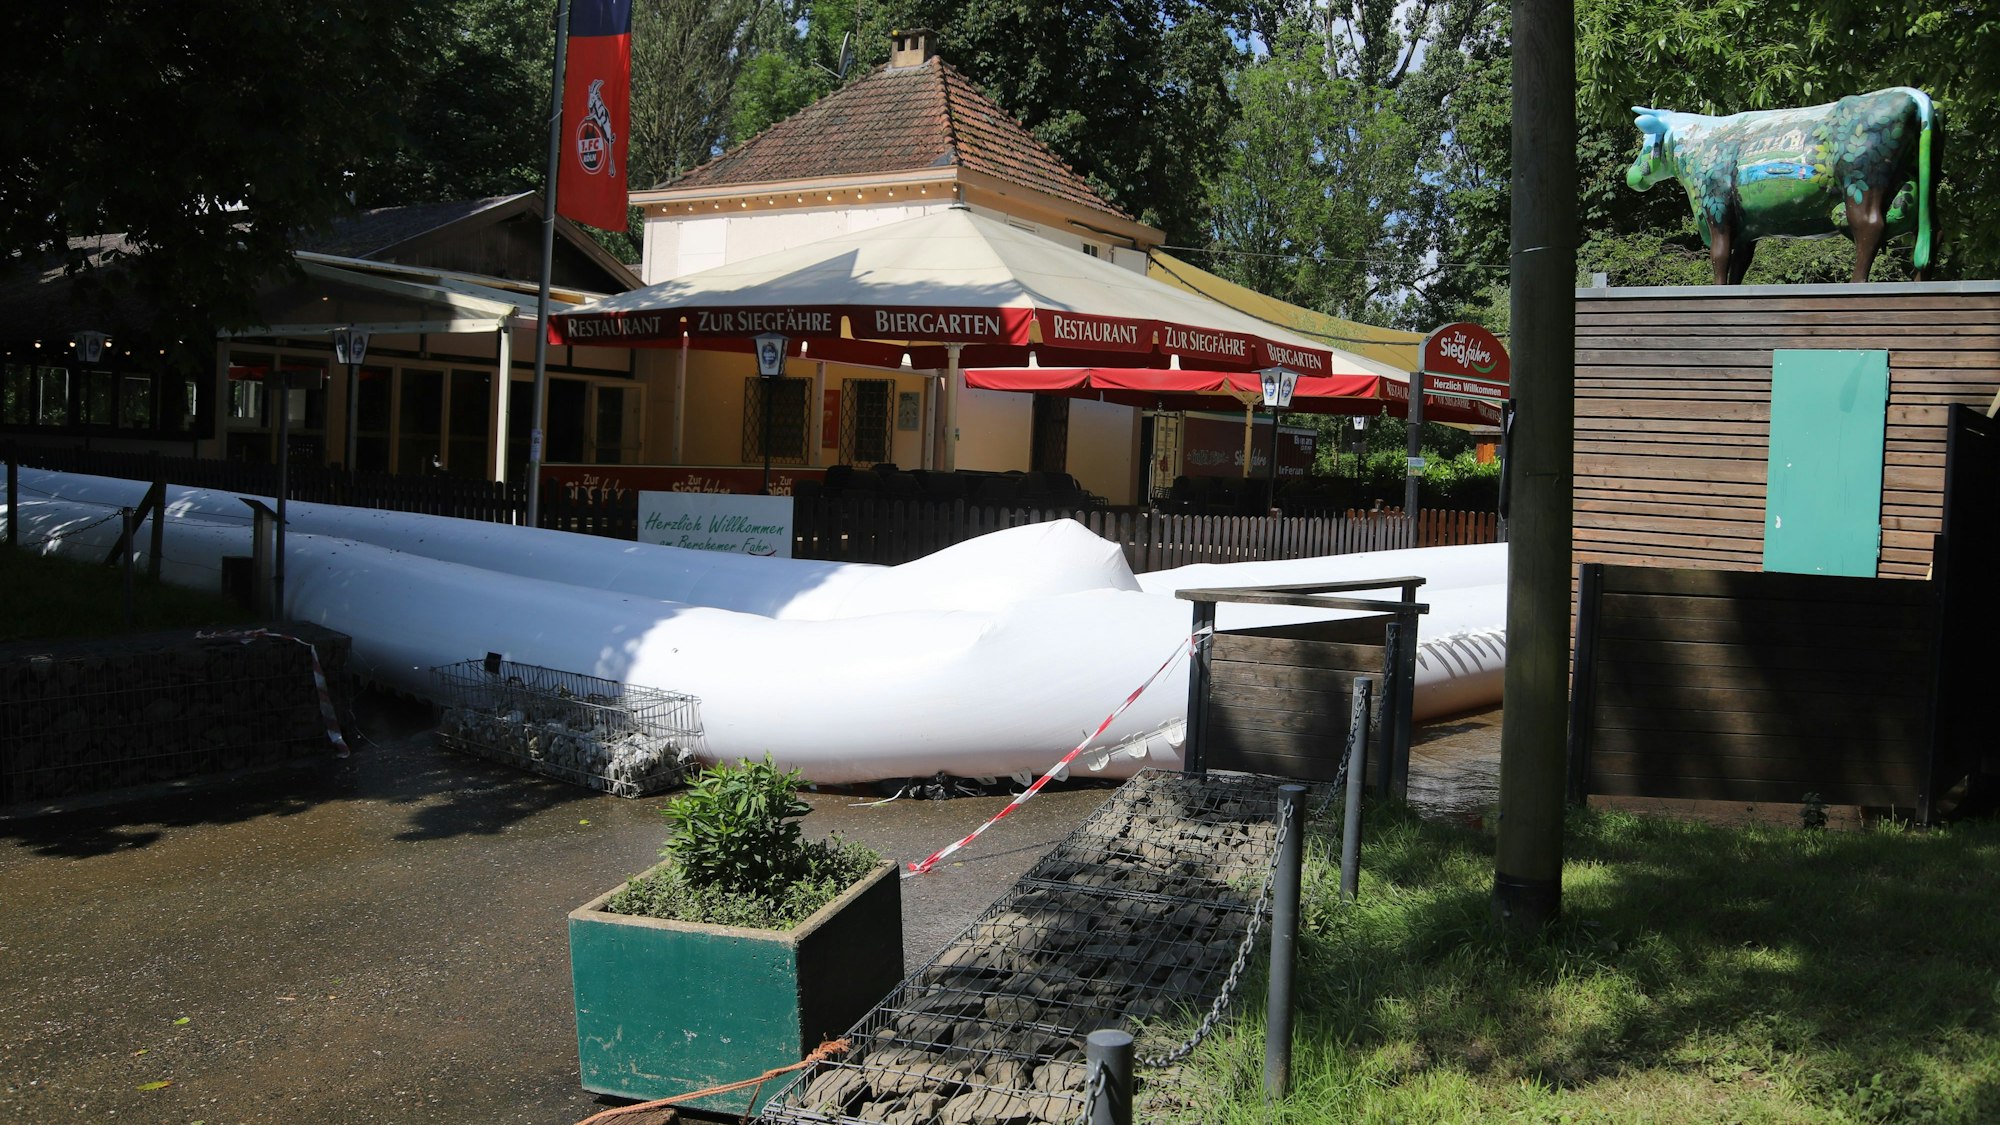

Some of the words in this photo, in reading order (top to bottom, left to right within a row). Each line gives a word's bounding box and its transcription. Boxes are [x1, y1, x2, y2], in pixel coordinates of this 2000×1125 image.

[567, 316, 661, 338] RESTAURANT
[698, 312, 734, 332] ZUR
[737, 308, 832, 332] SIEGFÄHRE
[875, 310, 1001, 336] BIERGARTEN
[1053, 315, 1138, 344] RESTAURANT
[1165, 326, 1188, 349] ZUR
[1189, 330, 1246, 357] SIEGFÄHRE
[1454, 331, 1467, 345] Zur
[1267, 343, 1322, 370] BIERGARTEN
[1434, 378, 1462, 392] Herzlich
[1463, 382, 1501, 396] Willkommen
[583, 473, 600, 485] Zur
[688, 475, 702, 485] Zur
[780, 476, 792, 486] Zur
[644, 511, 702, 531] Herzlich
[709, 515, 784, 536] Willkommen
